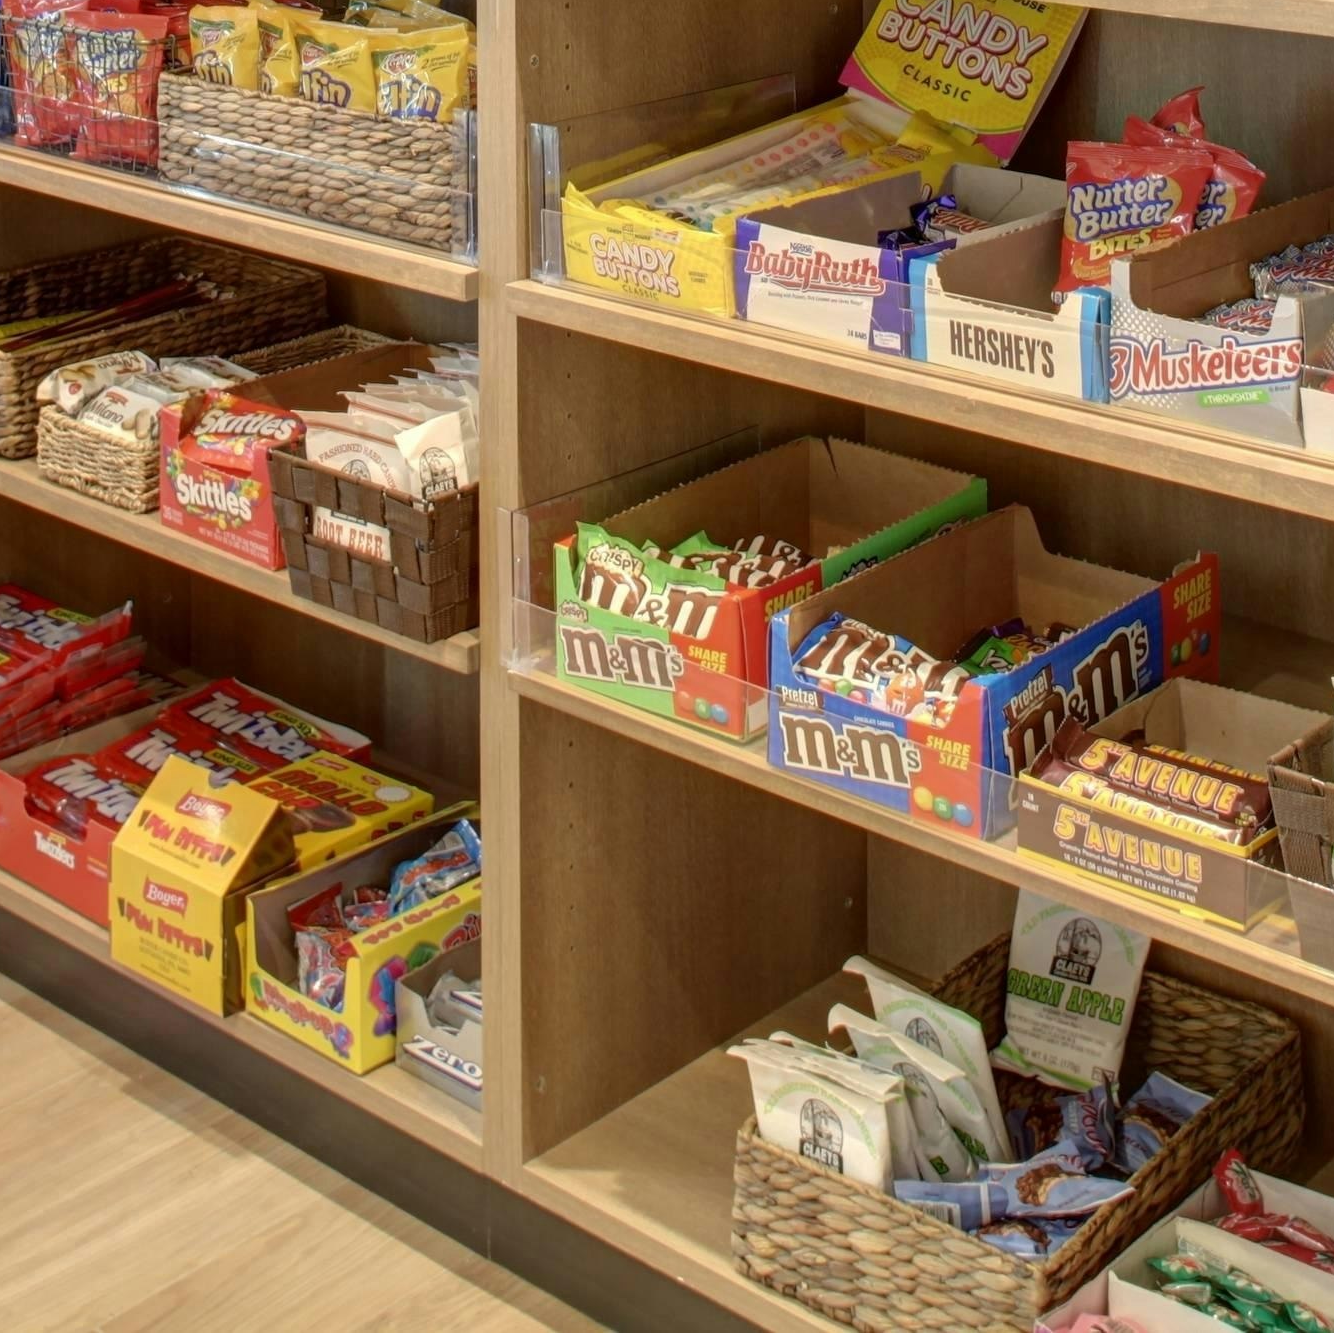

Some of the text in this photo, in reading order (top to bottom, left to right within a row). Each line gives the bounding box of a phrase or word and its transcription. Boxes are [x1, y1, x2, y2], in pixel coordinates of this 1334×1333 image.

[876, 10, 1033, 101] BUTTONS
[902, 64, 973, 103] CLASSIC
[1071, 177, 1167, 213] Nutter
[1076, 200, 1172, 240] Butter
[590, 234, 674, 276] CANDY
[1089, 229, 1153, 261] BITES
[593, 256, 680, 297] BUTTONS
[949, 319, 1056, 379] HERSHEY'S
[1110, 338, 1302, 390] 3 Musketeers
[194, 410, 297, 441] Skittles
[176, 474, 252, 521] Skittles
[349, 527, 384, 559] BEER
[1173, 569, 1213, 610] SHARE
[1186, 590, 1212, 623] SIZE
[688, 644, 728, 665] SHARE
[700, 660, 727, 675] SIZE
[781, 686, 818, 707] Pretzel
[1010, 670, 1049, 716] Pretzel
[926, 735, 971, 757] SHARE
[939, 751, 969, 771] SIZE
[1110, 752, 1244, 815] AVENUE
[1084, 822, 1202, 884] AVENUE
[146, 884, 184, 906] Boyer
[1006, 968, 1126, 1025] GREEN APPLE
